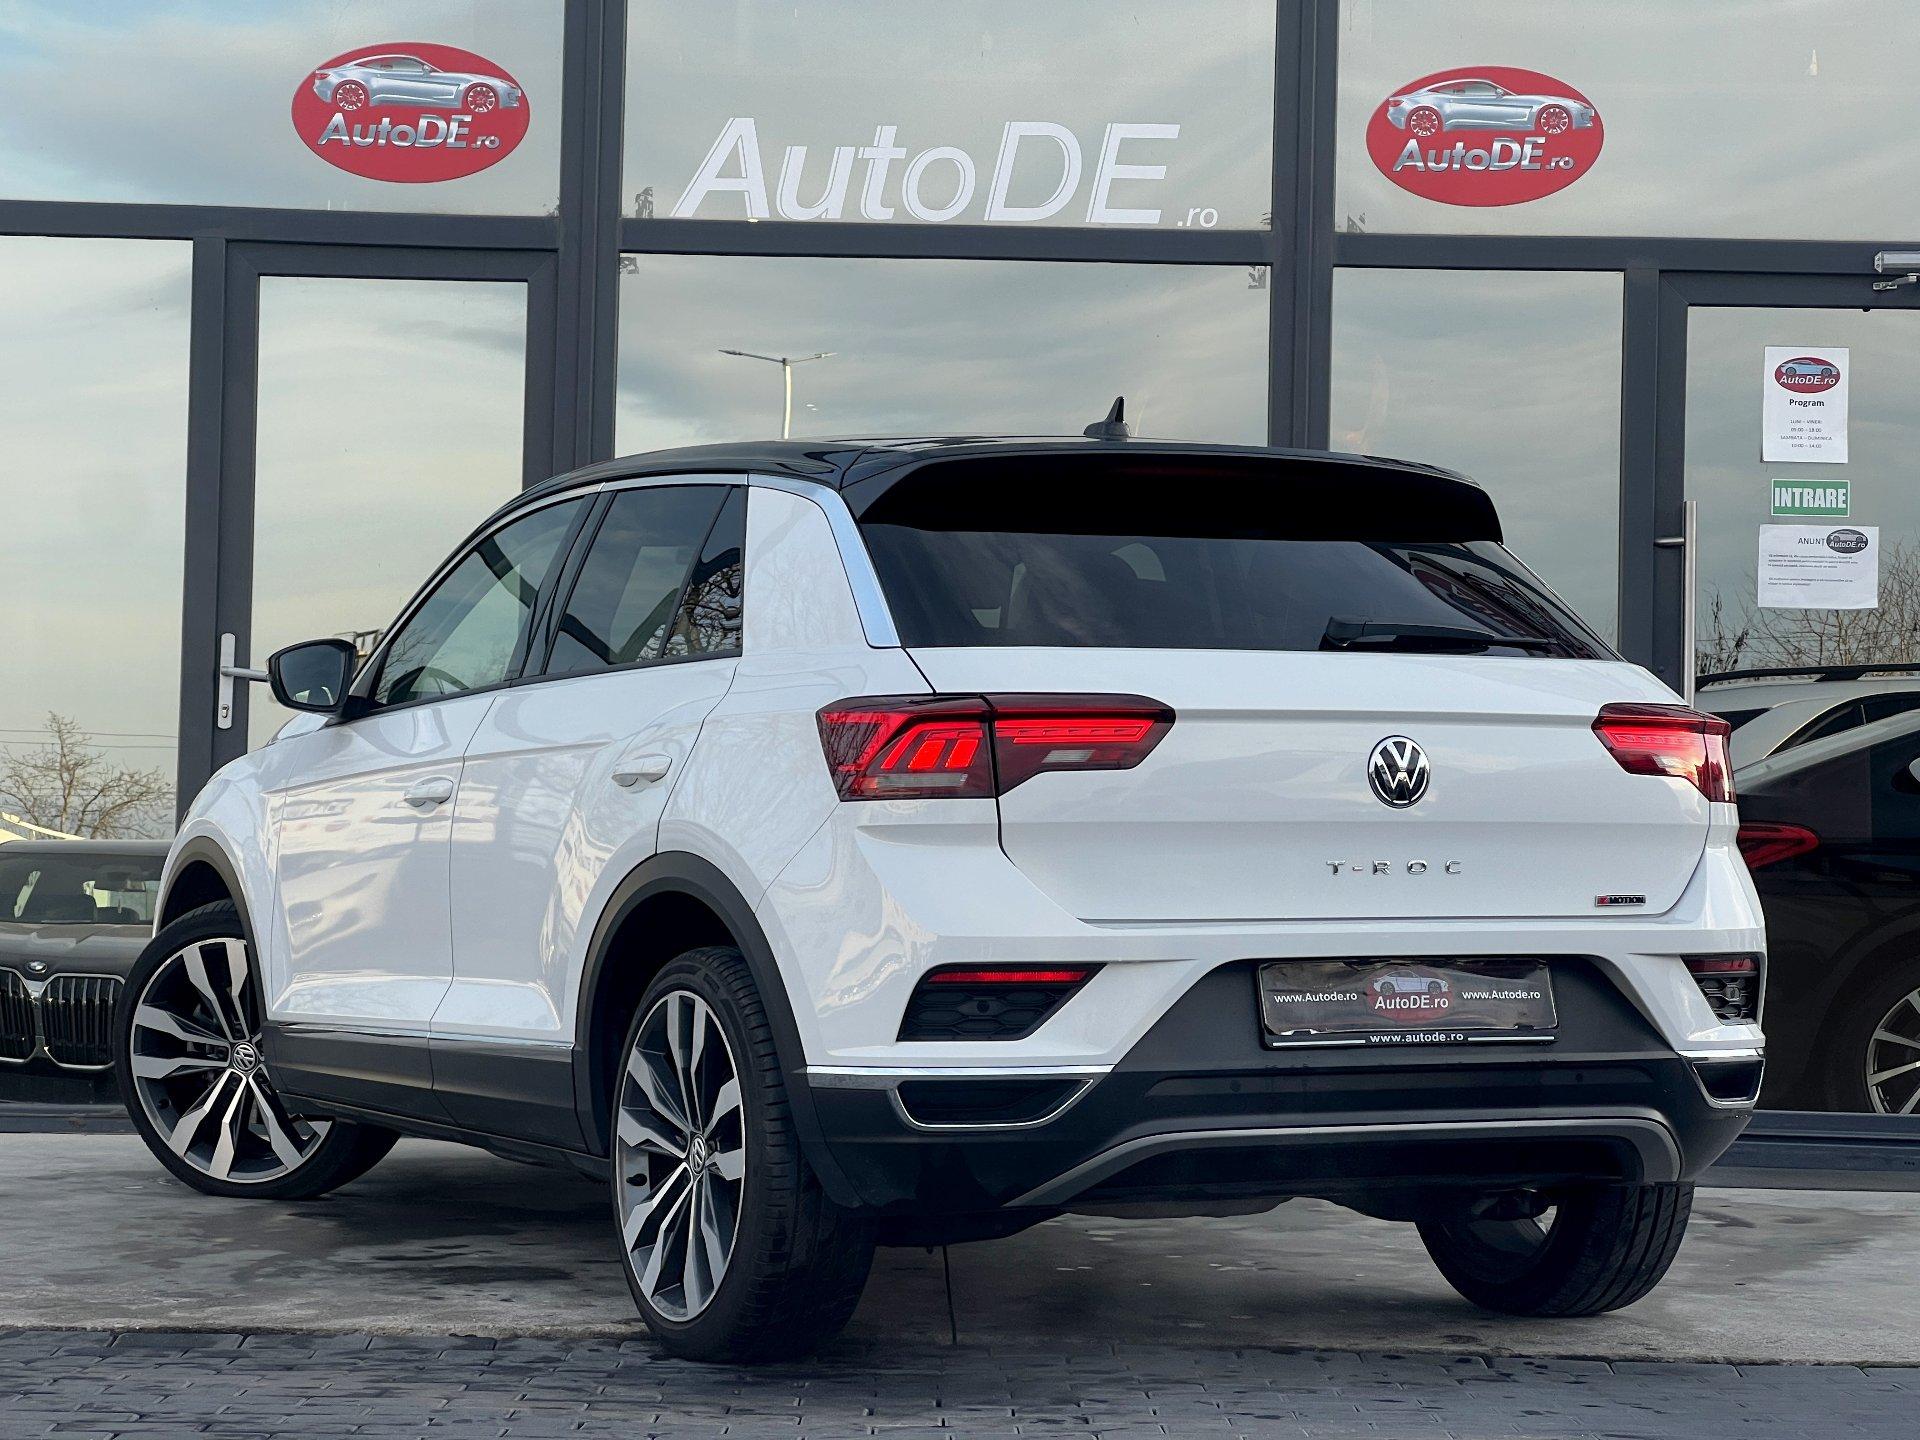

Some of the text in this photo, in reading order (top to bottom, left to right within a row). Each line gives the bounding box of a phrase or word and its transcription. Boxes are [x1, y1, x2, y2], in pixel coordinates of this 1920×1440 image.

[317, 112, 501, 149] AutoDE.ro
[1392, 136, 1576, 172] AutoDE.ro
[1780, 375, 1836, 384] AutoDE.ro
[1789, 399, 1825, 407] Program
[1774, 487, 1847, 508] INTRARE
[1325, 859, 1463, 876] T-ROC
[1274, 991, 1358, 1004] www.Autode.ro
[1461, 989, 1541, 1001] www.Autode.ro
[1375, 995, 1449, 1010] AutoDE.ro
[1369, 1031, 1464, 1043] www.autode.ro
